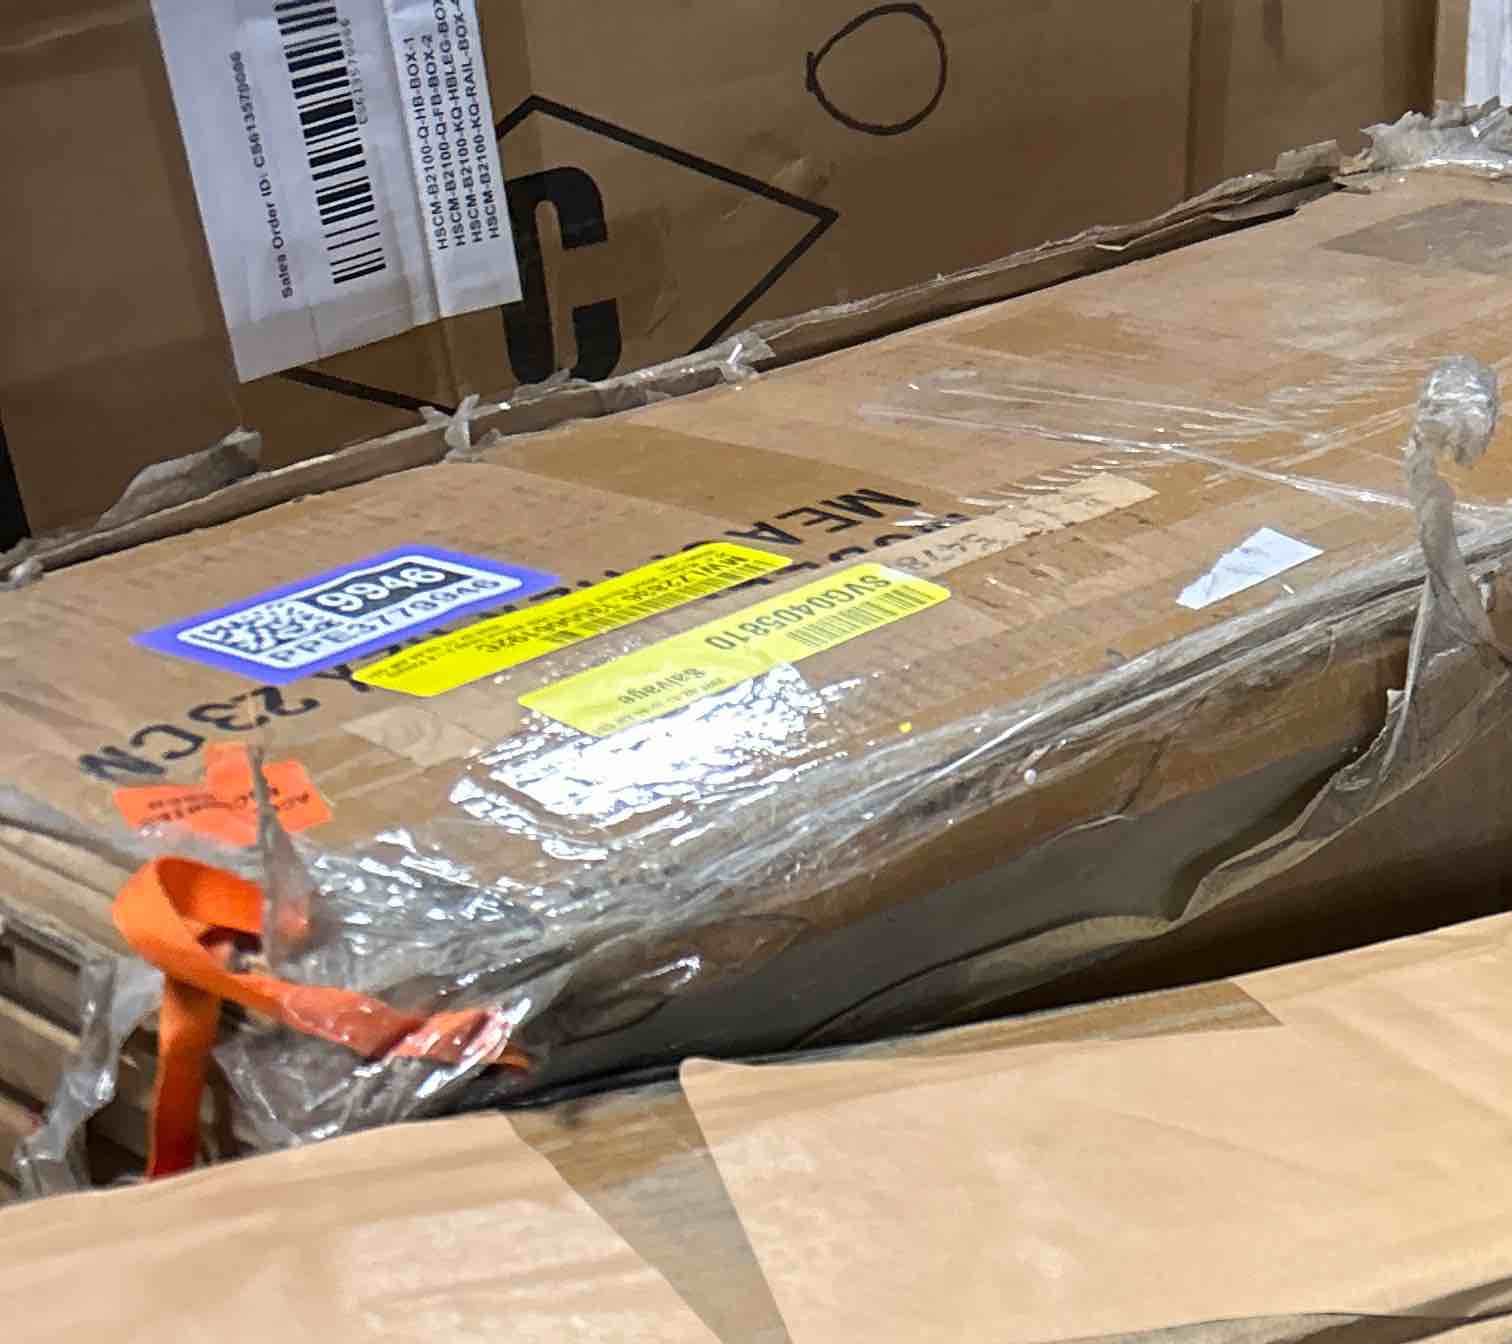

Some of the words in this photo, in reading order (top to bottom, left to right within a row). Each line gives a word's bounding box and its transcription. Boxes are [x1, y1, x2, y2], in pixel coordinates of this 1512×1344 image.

[269, 202, 286, 250] Order
[281, 255, 295, 299] Sales
[315, 566, 446, 612] 9946
[703, 573, 893, 651] SVG0405810
[617, 666, 707, 705] Salvage
